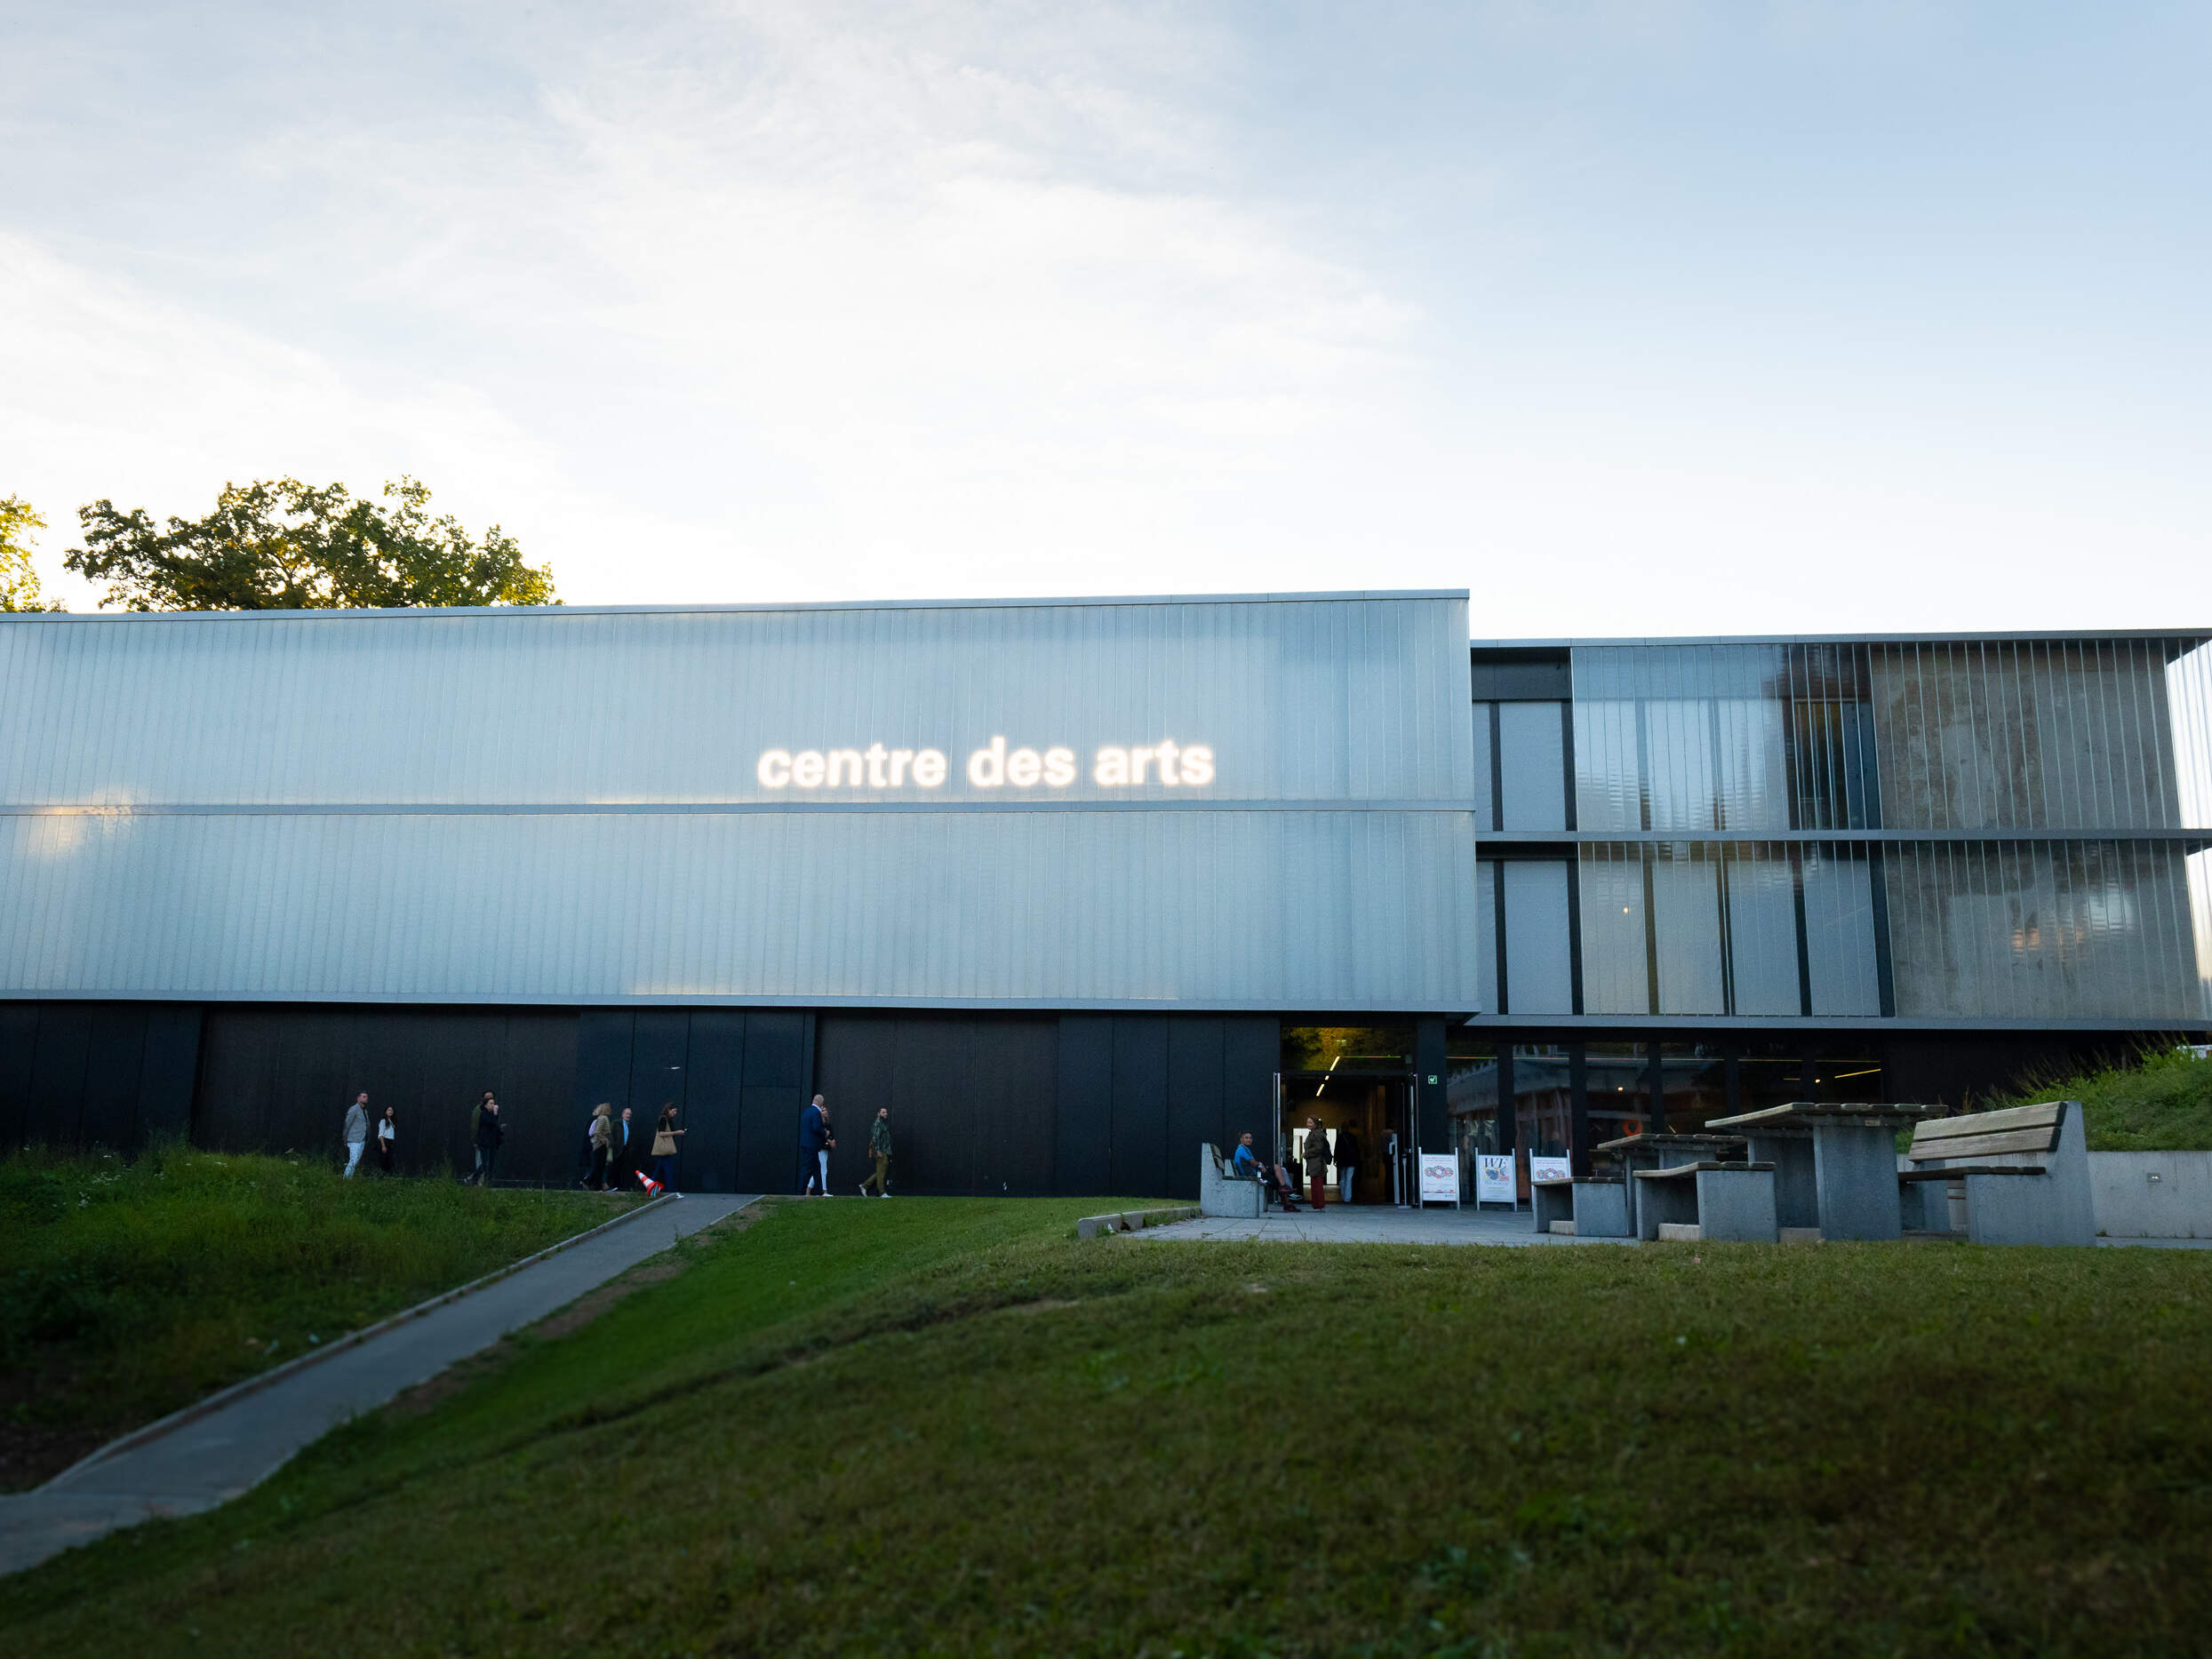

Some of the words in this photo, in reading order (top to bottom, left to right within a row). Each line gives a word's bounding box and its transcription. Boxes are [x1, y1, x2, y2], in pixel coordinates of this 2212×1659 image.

[758, 743, 946, 786] centre
[969, 736, 1075, 786] des
[1094, 739, 1214, 785] arts
